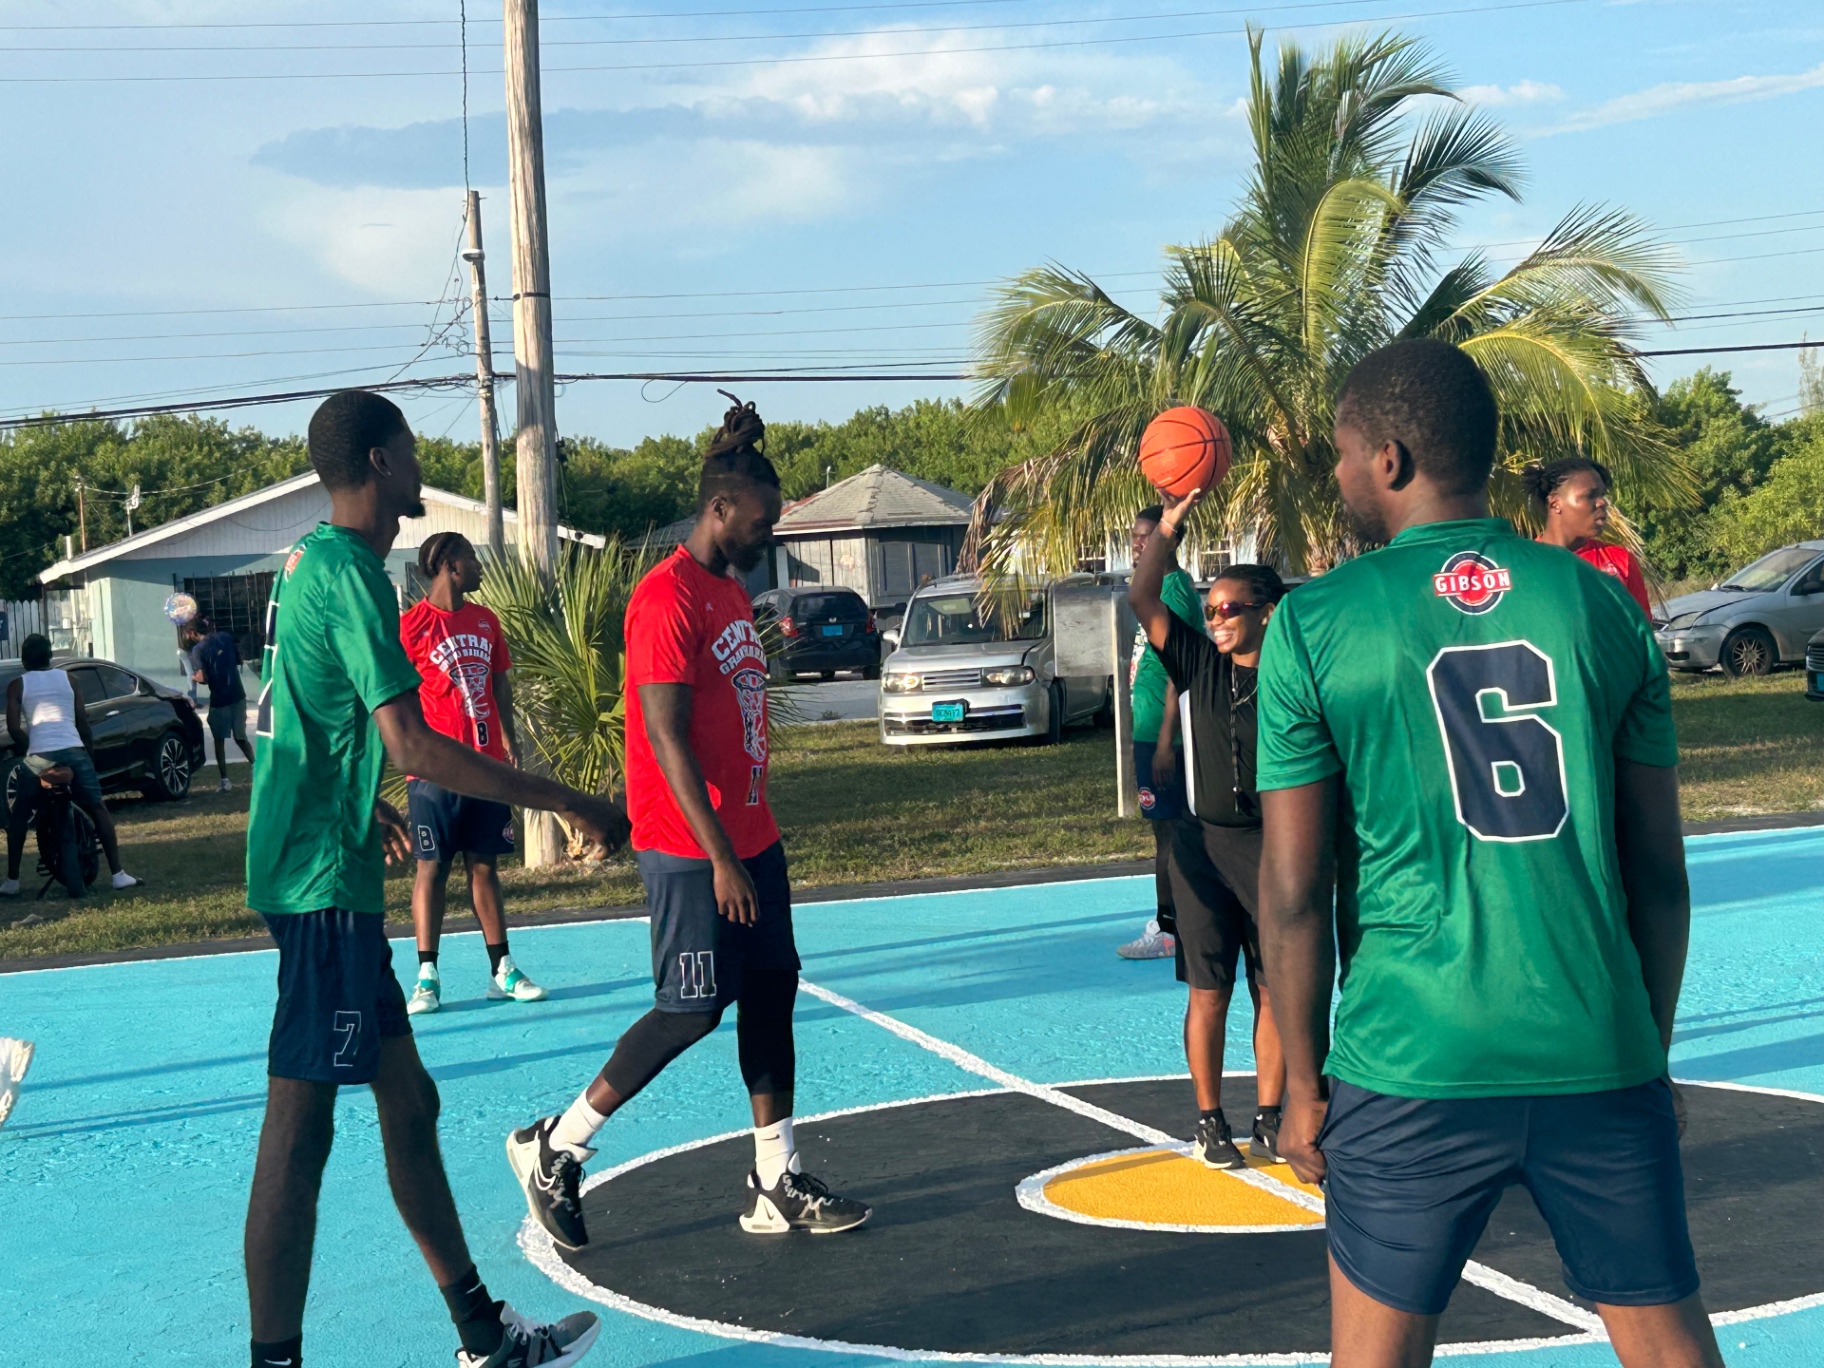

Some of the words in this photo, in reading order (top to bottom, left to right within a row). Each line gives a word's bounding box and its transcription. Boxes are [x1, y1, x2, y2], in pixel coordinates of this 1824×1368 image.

[1434, 571, 1511, 593] GIBSON
[1426, 639, 1570, 843] 6
[679, 950, 717, 999] 11
[333, 1010, 362, 1067] 7
